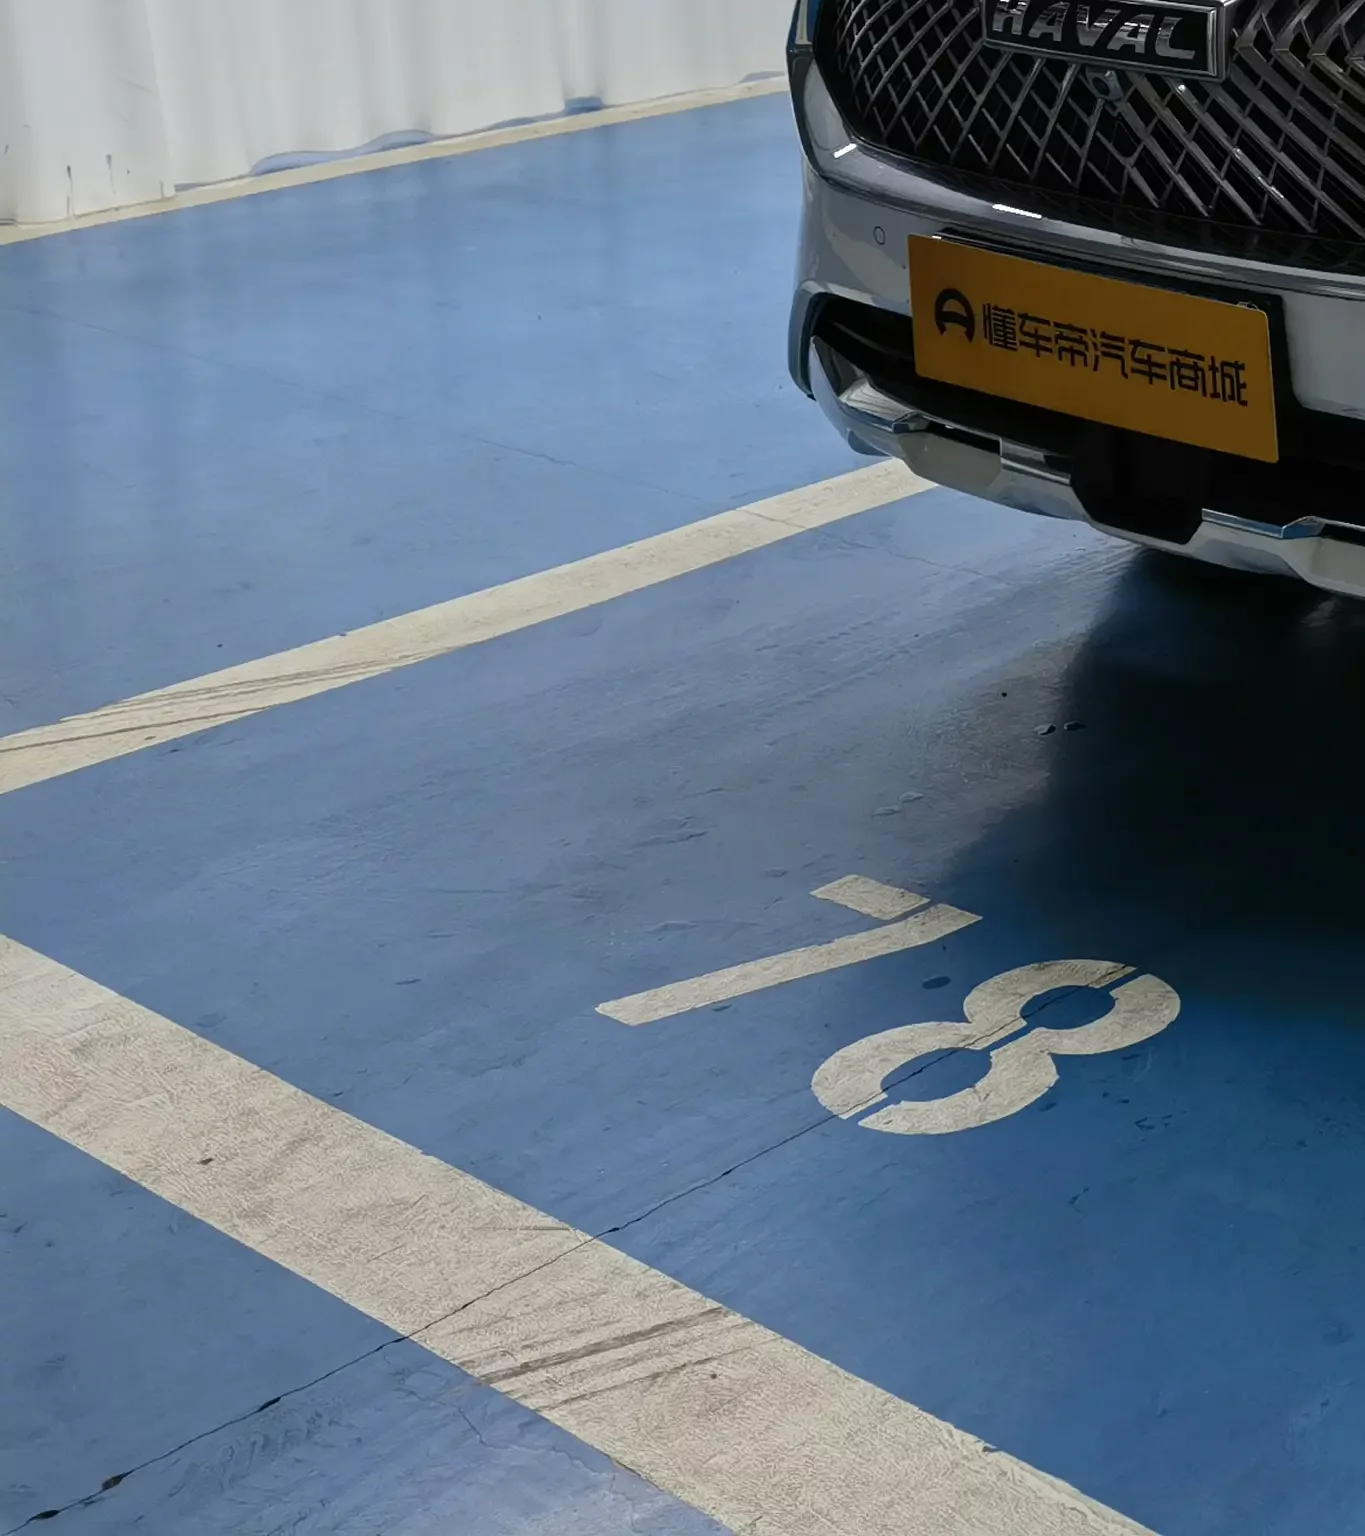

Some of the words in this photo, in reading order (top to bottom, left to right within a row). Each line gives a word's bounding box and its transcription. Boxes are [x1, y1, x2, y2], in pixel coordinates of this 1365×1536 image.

[981, 302, 1249, 407] 懂车帝汽车商城
[594, 873, 1182, 1136] 18
